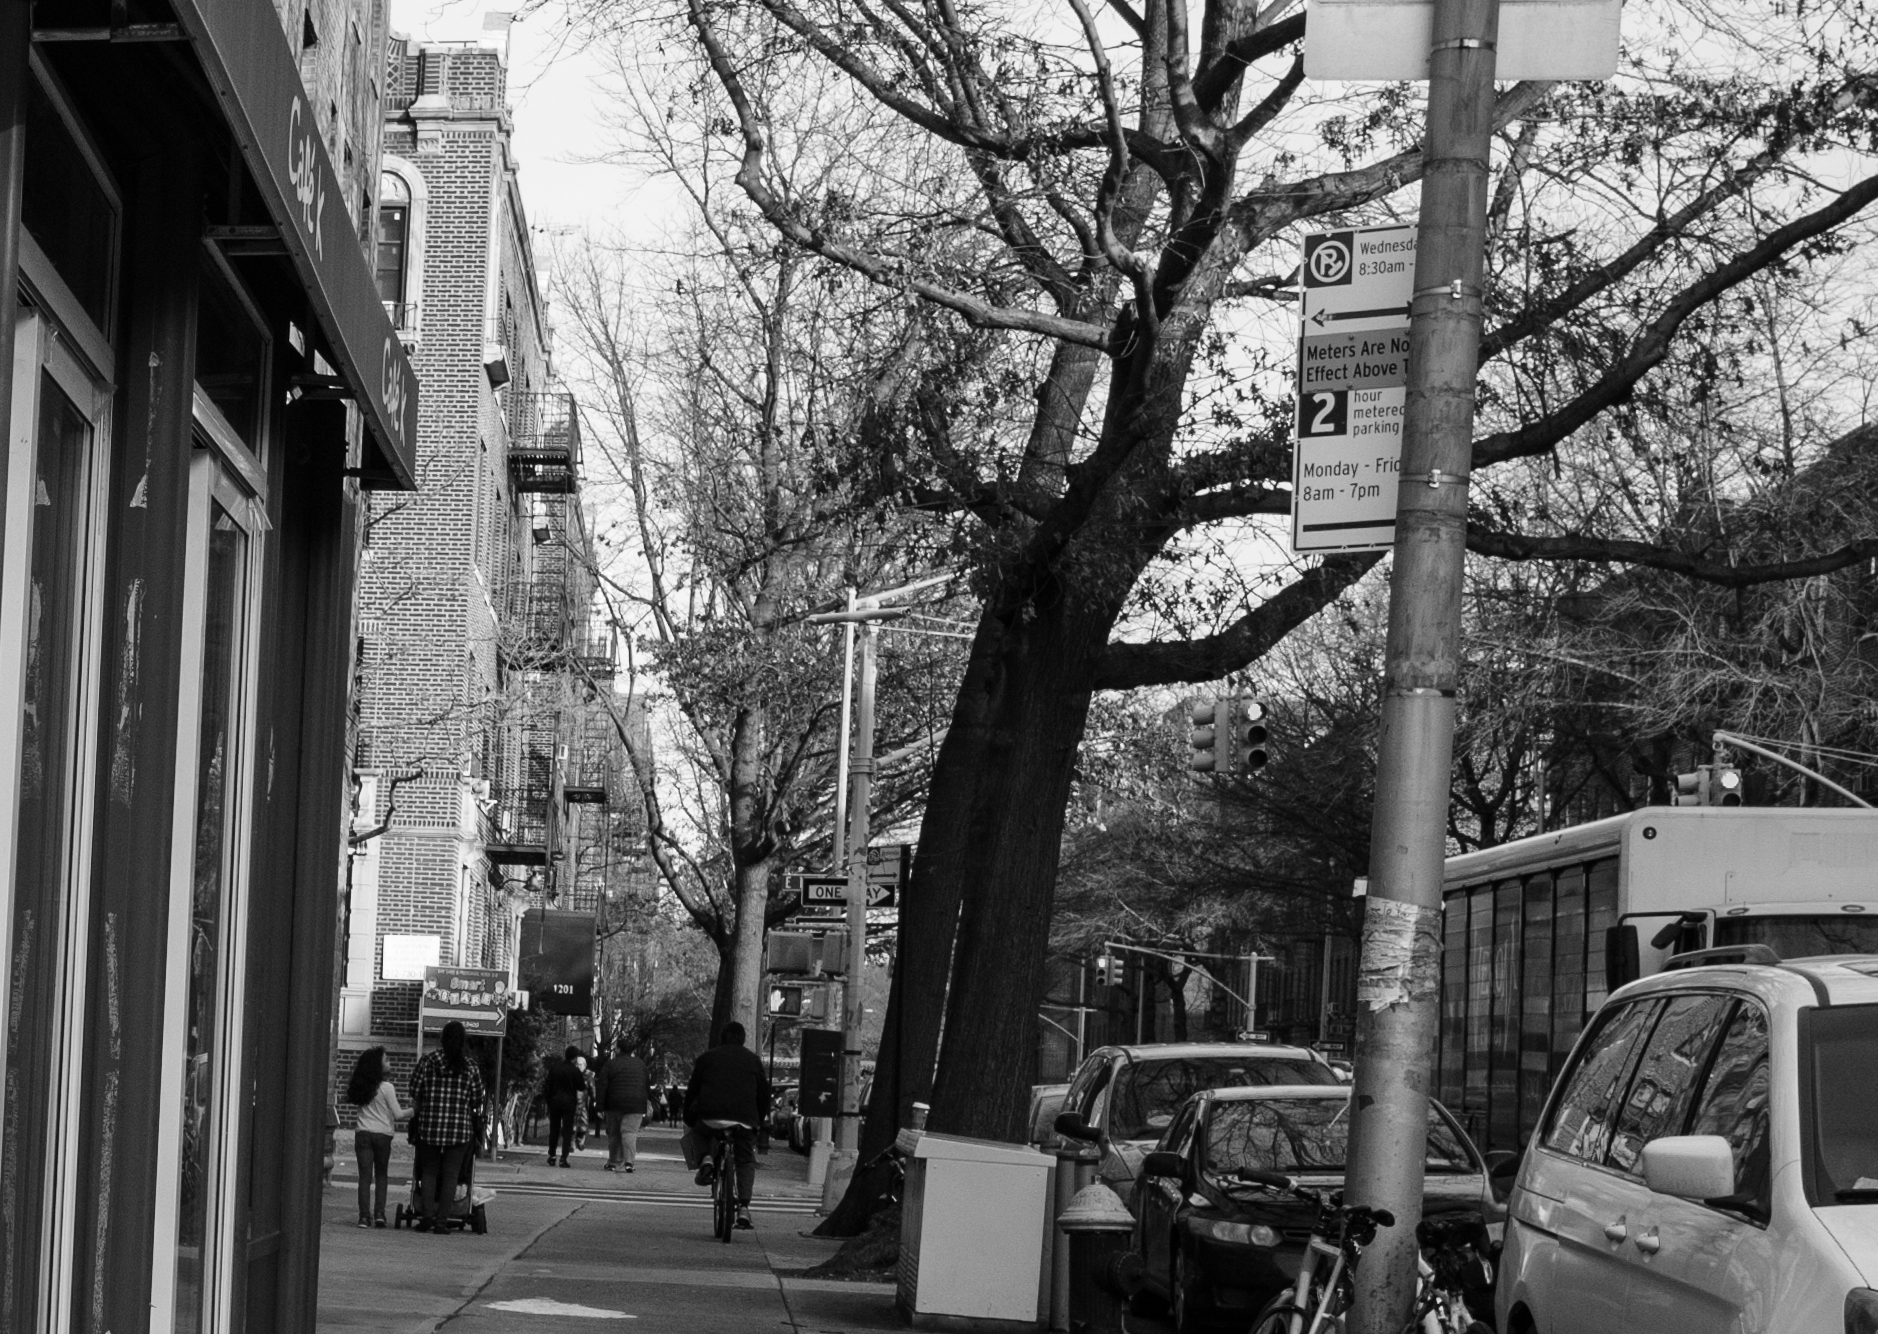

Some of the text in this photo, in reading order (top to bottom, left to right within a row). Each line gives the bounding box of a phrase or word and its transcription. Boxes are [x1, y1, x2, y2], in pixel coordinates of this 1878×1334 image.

[289, 96, 316, 234] Café
[1360, 237, 1418, 255] Wednesda
[1359, 260, 1404, 276] 8:30am
[1307, 338, 1410, 361] Meters Are No
[1306, 363, 1349, 383] Effect
[1353, 360, 1398, 378] Above
[382, 337, 401, 431] Café
[1353, 391, 1382, 404] hour
[1311, 392, 1335, 433] 2
[1353, 421, 1400, 438] parking
[1303, 460, 1359, 479] Monday
[1375, 457, 1402, 474] Fri
[1303, 485, 1335, 502] 8am
[1349, 482, 1380, 500] 7pm
[816, 886, 842, 898] ONE
[385, 970, 424, 979] 212-730-1
[553, 984, 573, 994] 1201
